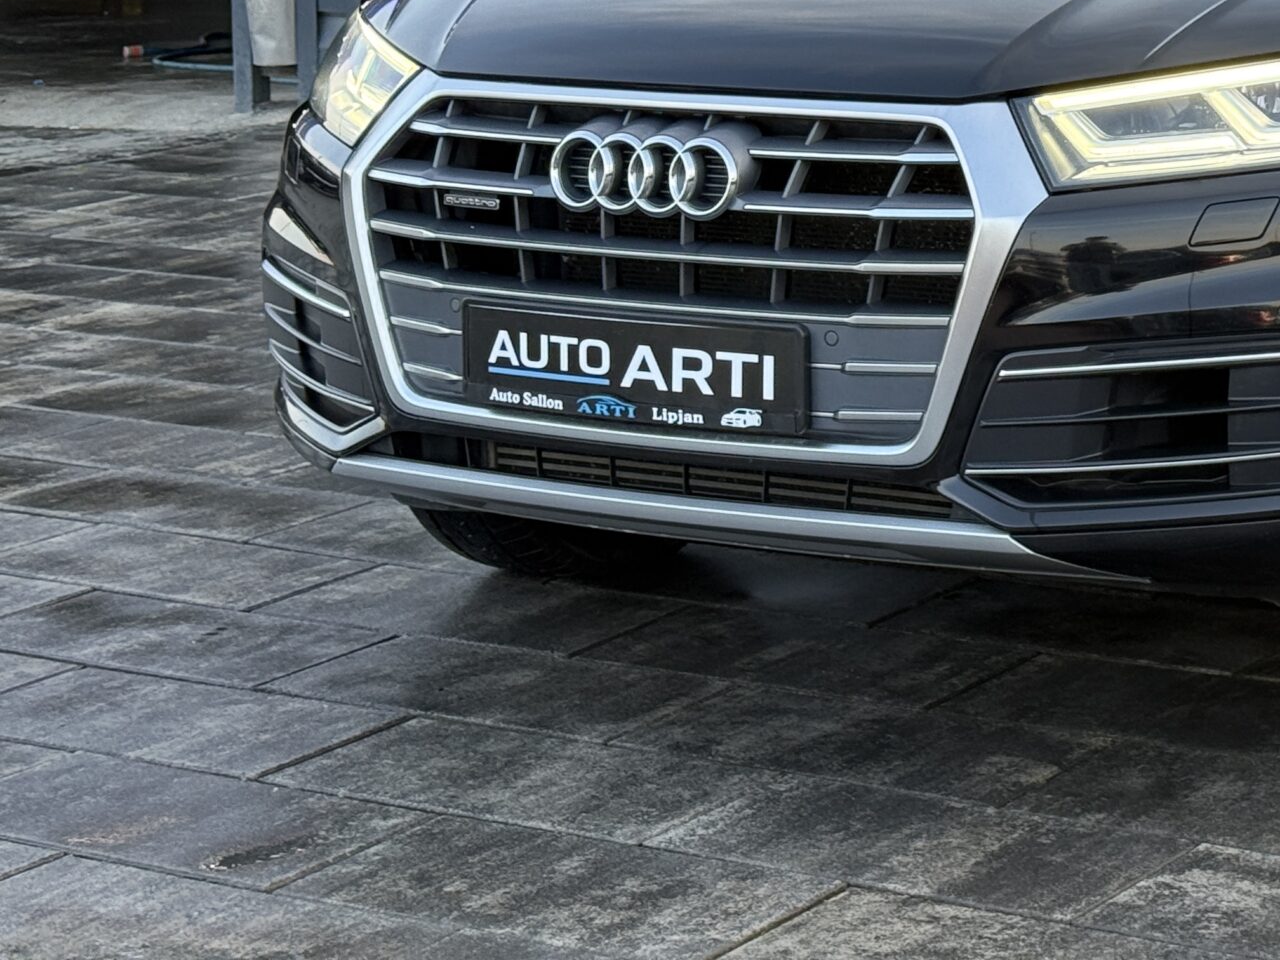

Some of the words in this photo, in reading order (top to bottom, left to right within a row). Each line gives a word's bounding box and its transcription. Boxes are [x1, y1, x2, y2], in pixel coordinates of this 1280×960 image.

[445, 195, 497, 208] quattro
[488, 329, 611, 376] AUTO
[619, 344, 775, 401] ARTI
[489, 387, 521, 405] Auto
[522, 391, 564, 410] Sallon
[577, 401, 637, 419] ARTI
[651, 407, 704, 425] Lipjan
